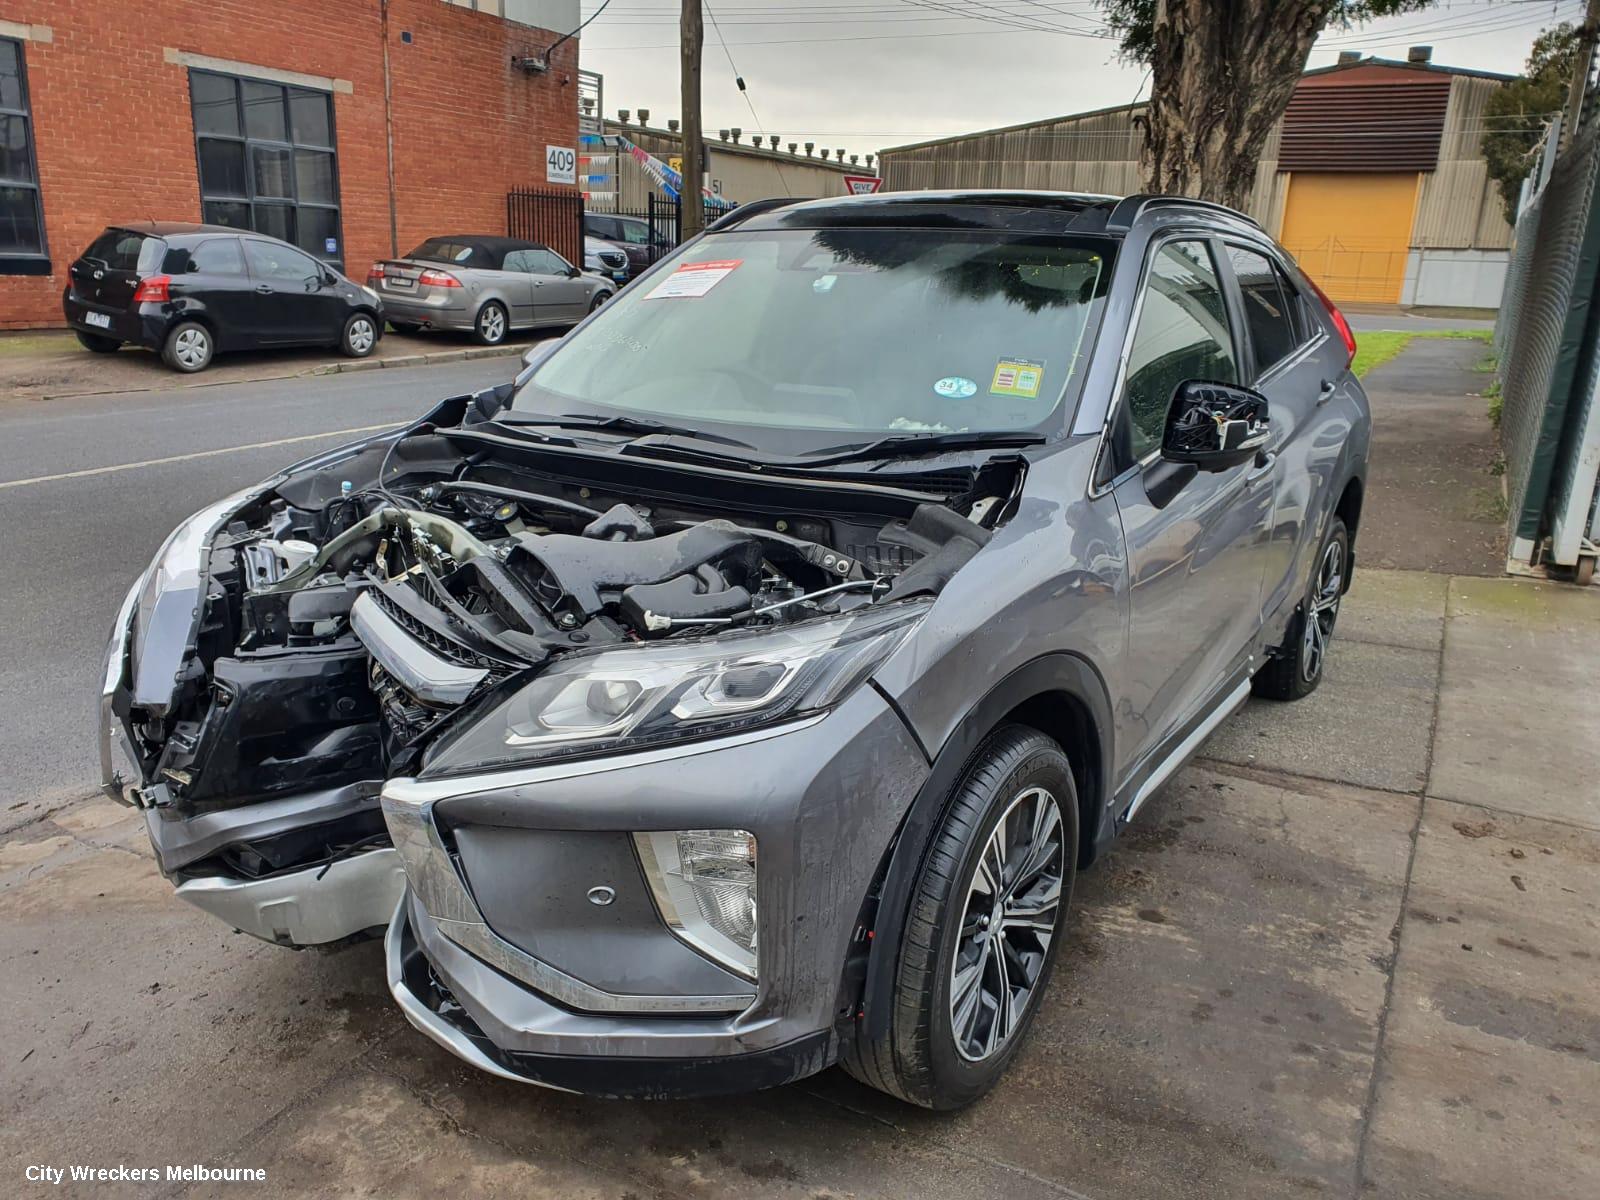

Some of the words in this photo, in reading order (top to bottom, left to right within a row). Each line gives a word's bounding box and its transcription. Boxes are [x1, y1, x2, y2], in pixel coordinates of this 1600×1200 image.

[548, 149, 574, 172] 409
[712, 179, 722, 194] 51
[939, 381, 954, 389] 34
